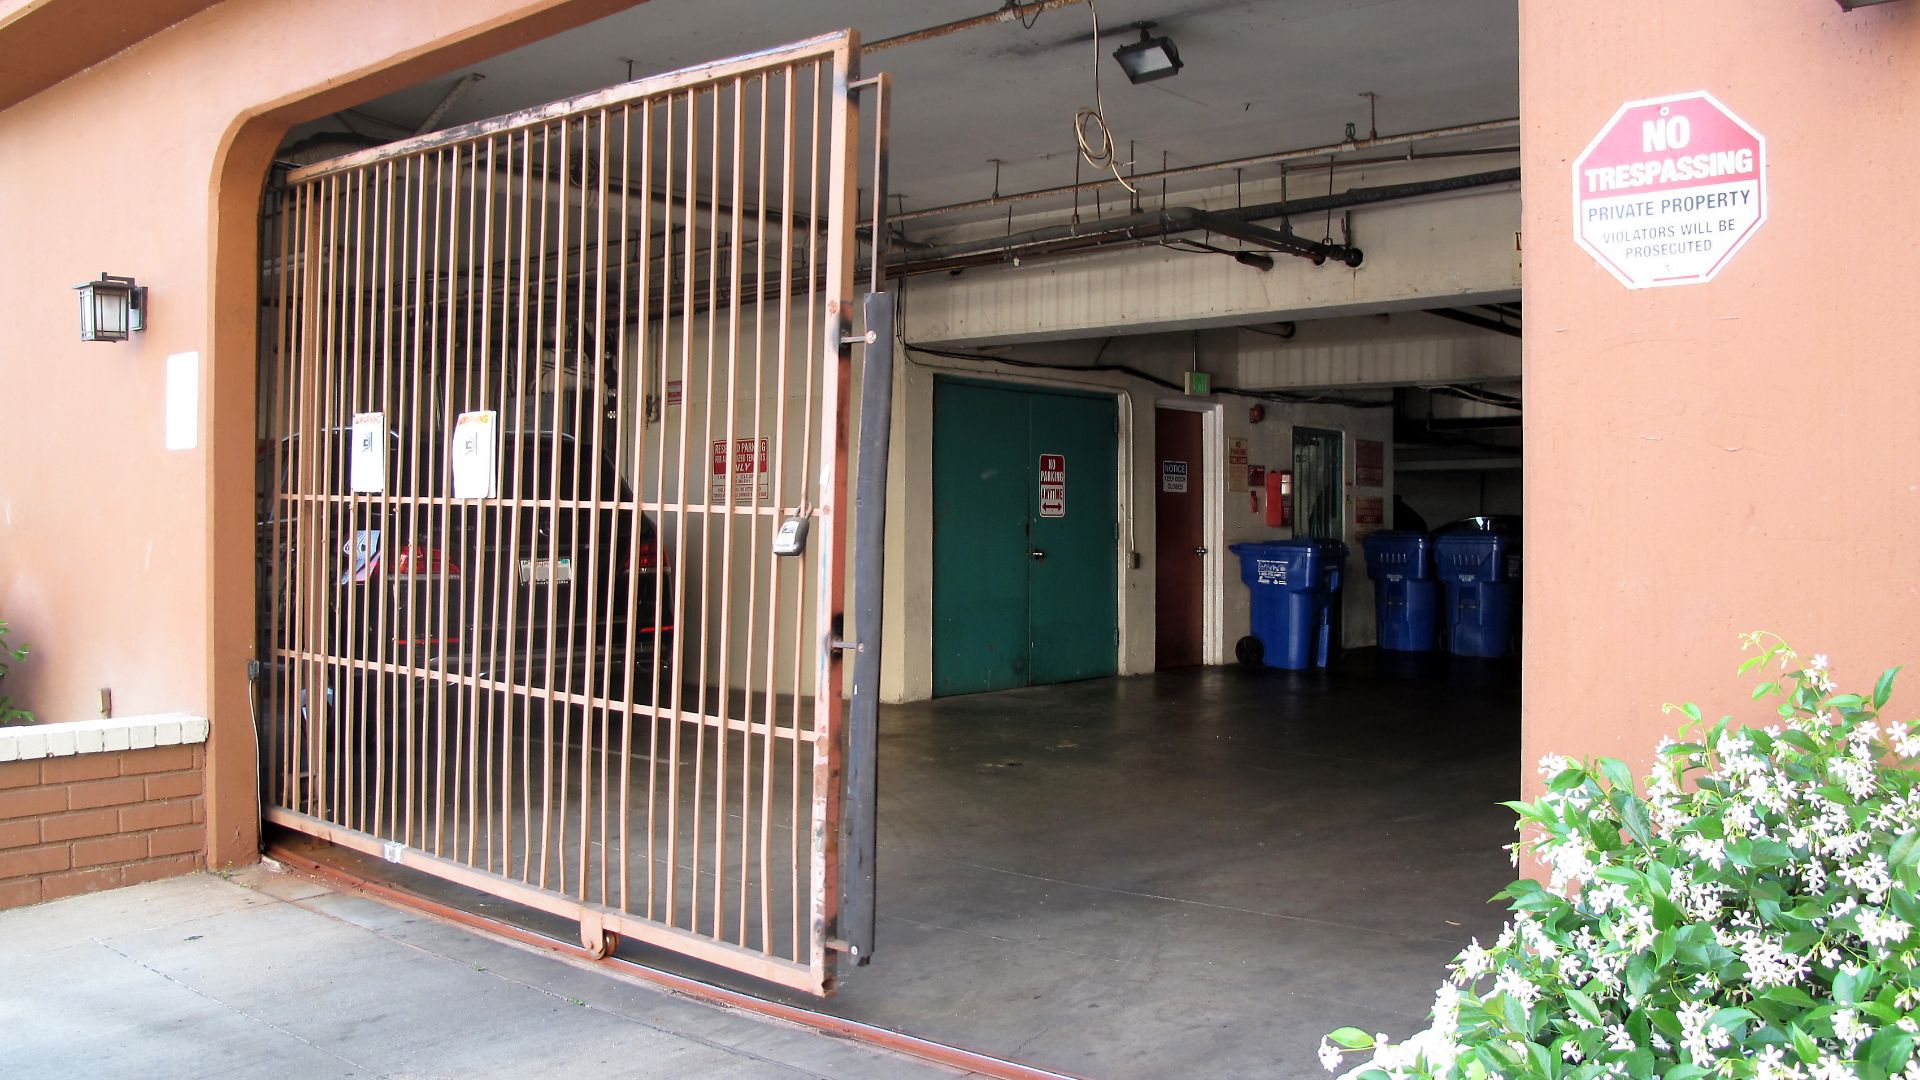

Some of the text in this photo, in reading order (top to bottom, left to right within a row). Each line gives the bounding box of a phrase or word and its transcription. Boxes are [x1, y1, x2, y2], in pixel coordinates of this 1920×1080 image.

[1642, 115, 1690, 152] NO
[1584, 148, 1753, 193] TRESPASSING
[1588, 189, 1750, 223] PRIVATE PROPERTY
[1603, 218, 1736, 244] VIOLATORS WILL BE
[1625, 239, 1712, 259] PROSECUTED
[1048, 458, 1056, 470] NO
[1164, 463, 1186, 474] NOTICE
[1040, 470, 1064, 482] PARKING
